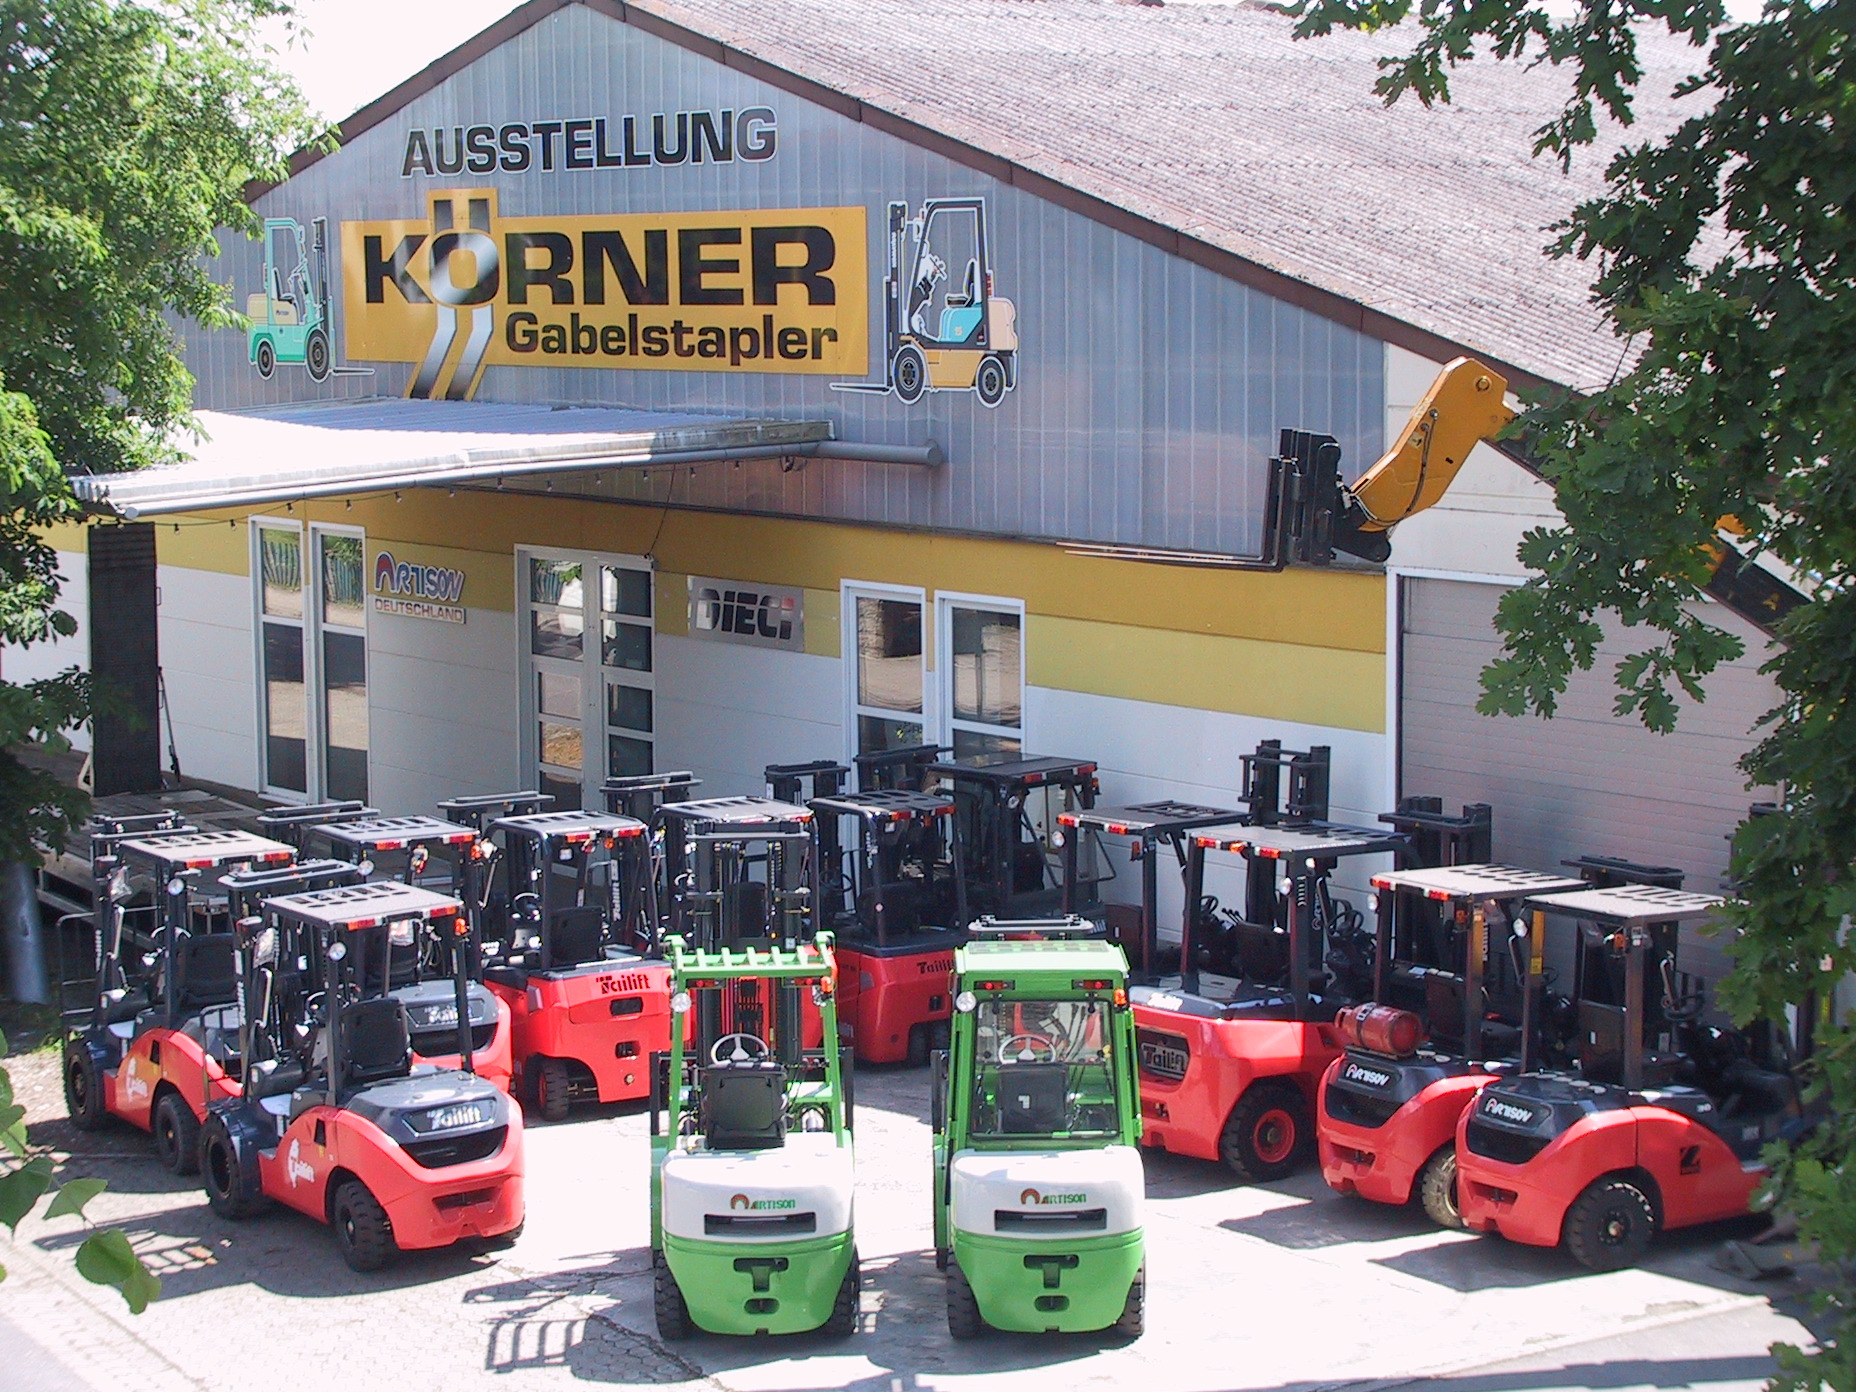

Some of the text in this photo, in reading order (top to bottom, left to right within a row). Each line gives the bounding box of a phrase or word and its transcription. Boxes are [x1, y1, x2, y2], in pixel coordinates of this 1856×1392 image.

[401, 106, 778, 177] AUSSTELLUNG
[363, 199, 836, 306] KÖRNER
[505, 312, 838, 366] Gabelstapler
[374, 551, 465, 603] ARTISON
[375, 598, 463, 622] DEUTSCHLAND
